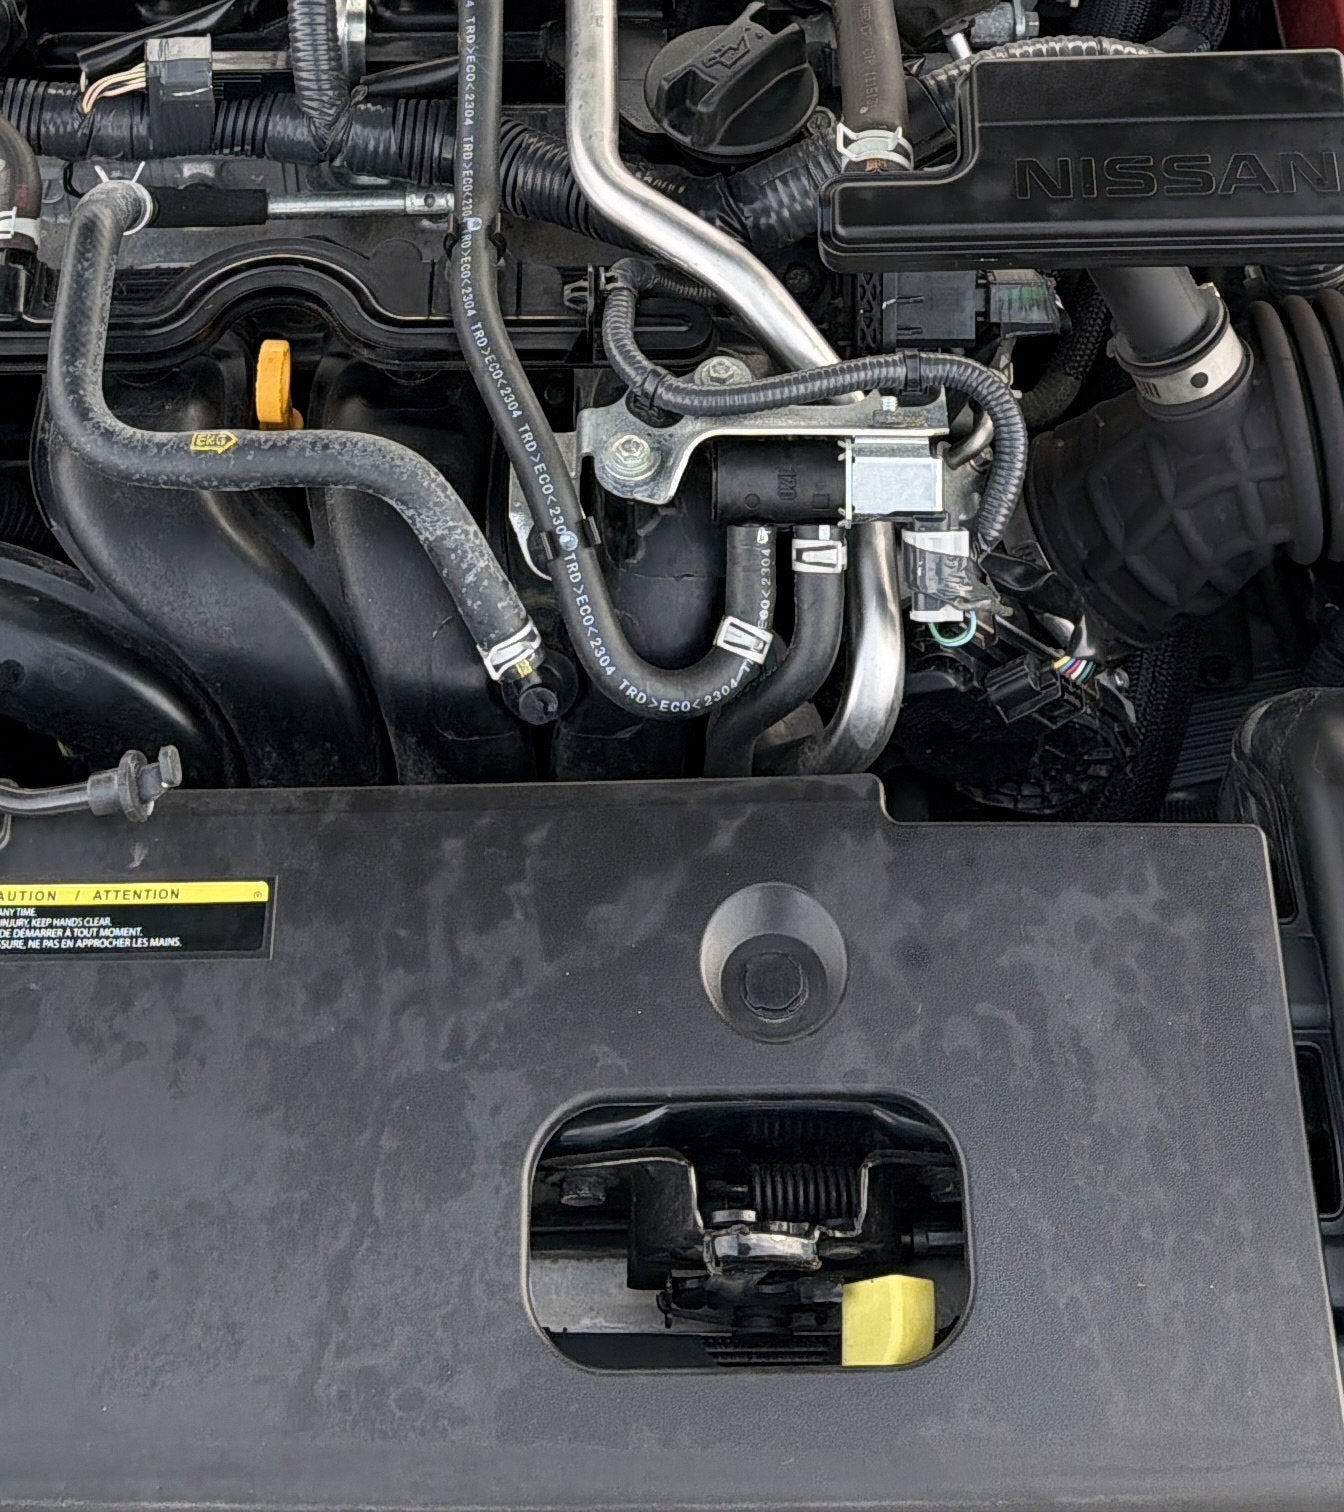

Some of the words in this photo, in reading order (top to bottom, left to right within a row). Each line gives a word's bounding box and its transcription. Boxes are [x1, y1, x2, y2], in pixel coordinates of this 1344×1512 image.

[1014, 150, 1341, 201] NISSAN
[92, 888, 181, 901] ATTENTION
[15, 907, 38, 917] TIME.
[30, 918, 52, 928] KEEP
[52, 917, 83, 927] HANDS
[83, 917, 112, 927] CLEAR.
[12, 927, 63, 939] DÉMARRER
[72, 927, 99, 938] TOUT
[99, 927, 144, 937] MOMENT.
[27, 939, 42, 949] NE
[42, 939, 61, 949] PAS
[61, 938, 74, 949] EN
[74, 937, 131, 949] APPROCHER
[132, 937, 149, 948] LES
[149, 936, 183, 947] MAINS.
